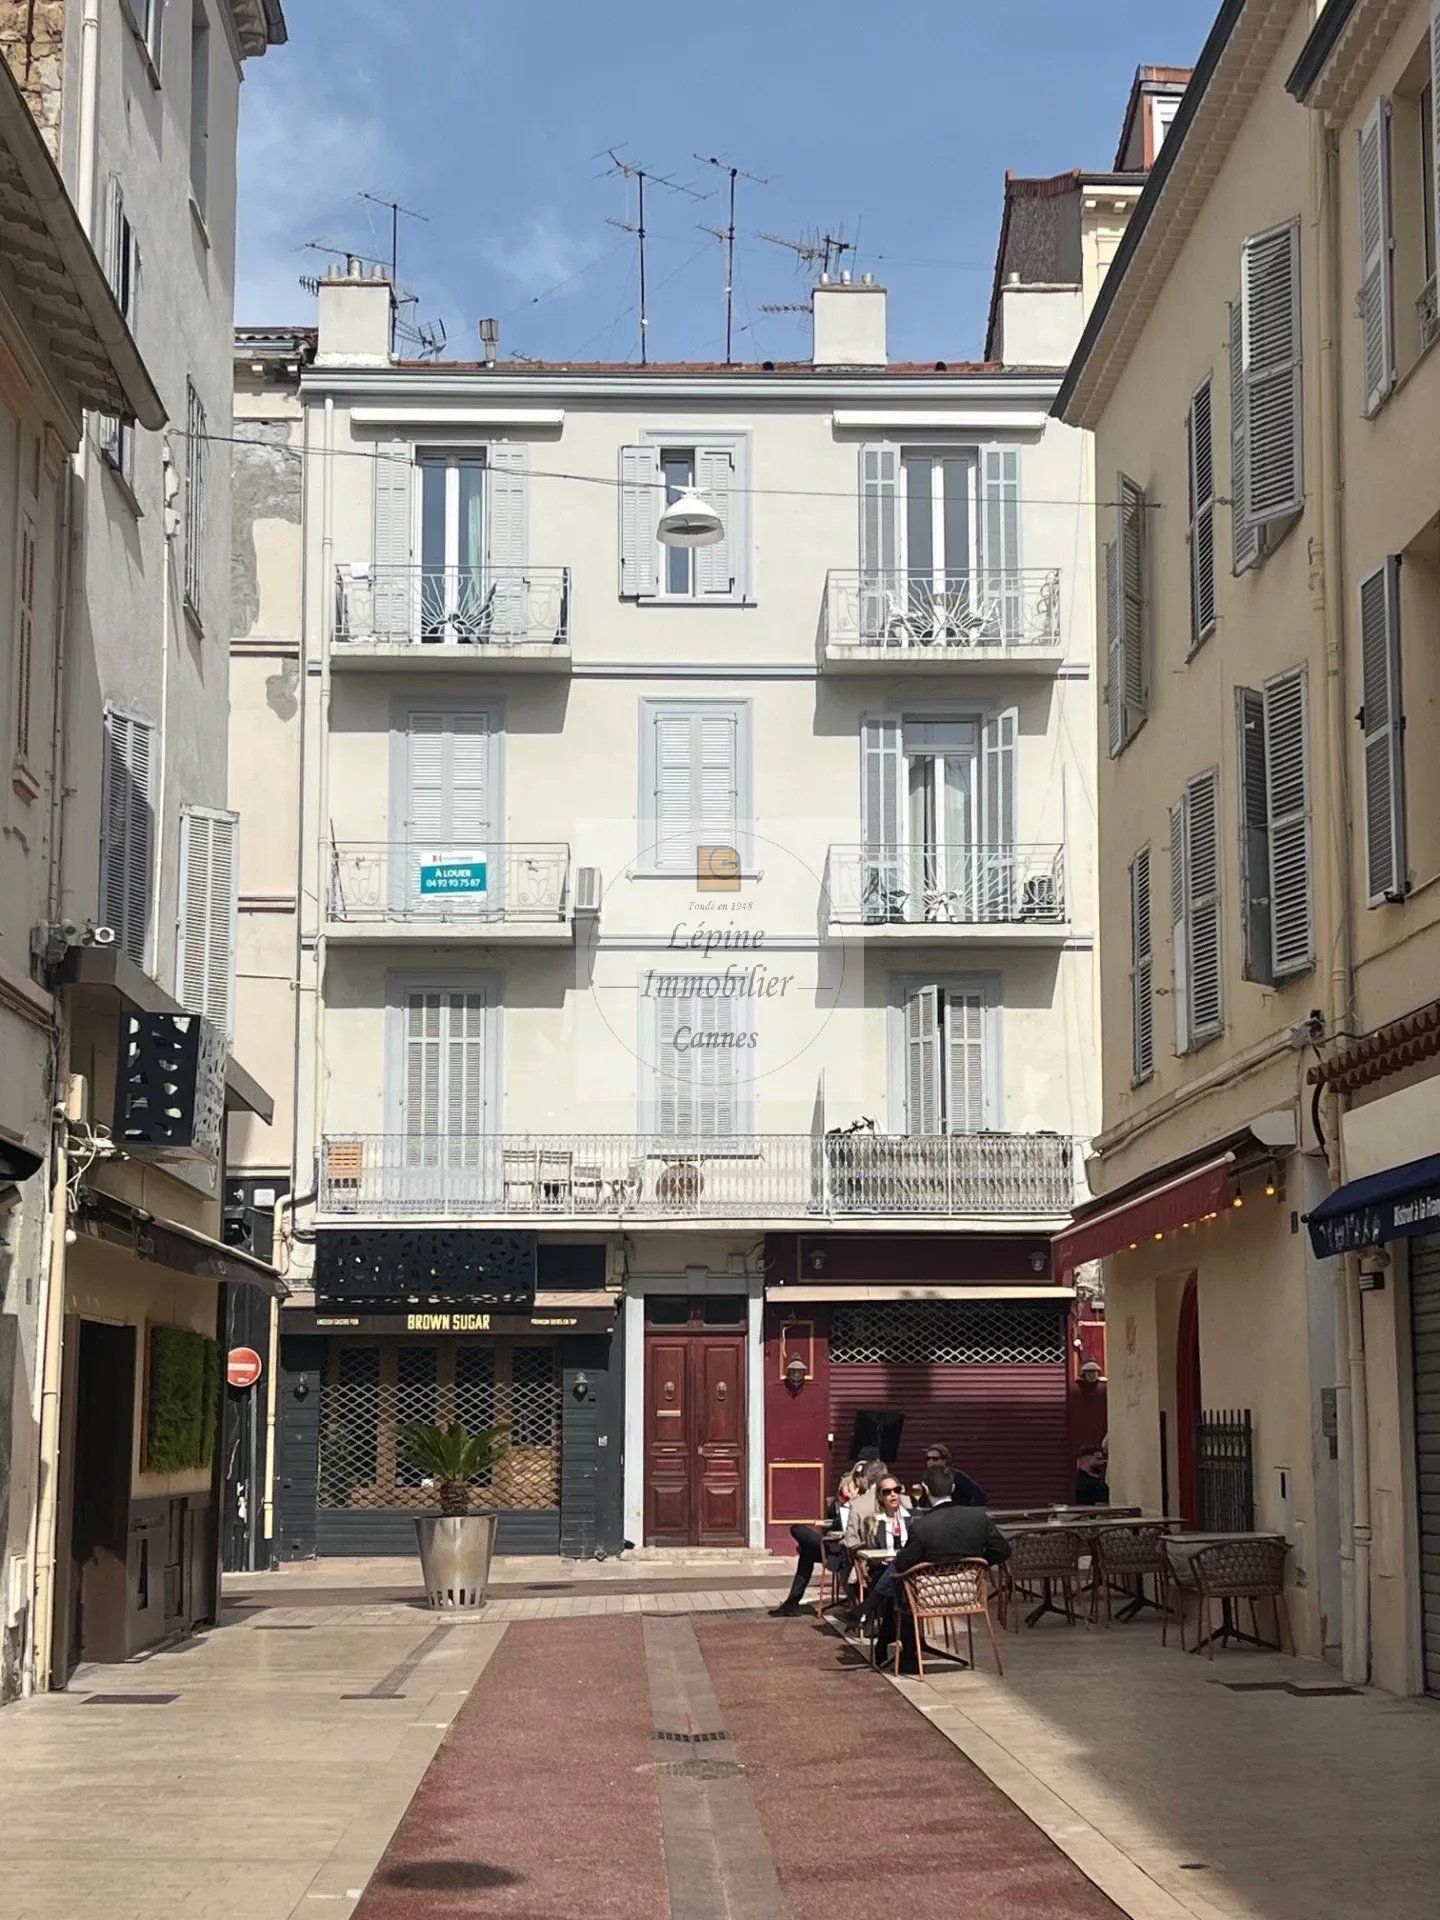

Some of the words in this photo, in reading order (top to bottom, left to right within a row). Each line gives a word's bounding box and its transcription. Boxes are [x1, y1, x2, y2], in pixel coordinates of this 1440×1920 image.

[443, 869, 471, 877] LOUER
[437, 879, 447, 887] 92
[407, 1314, 450, 1330] BROWN
[452, 1314, 490, 1330] SUGAR
